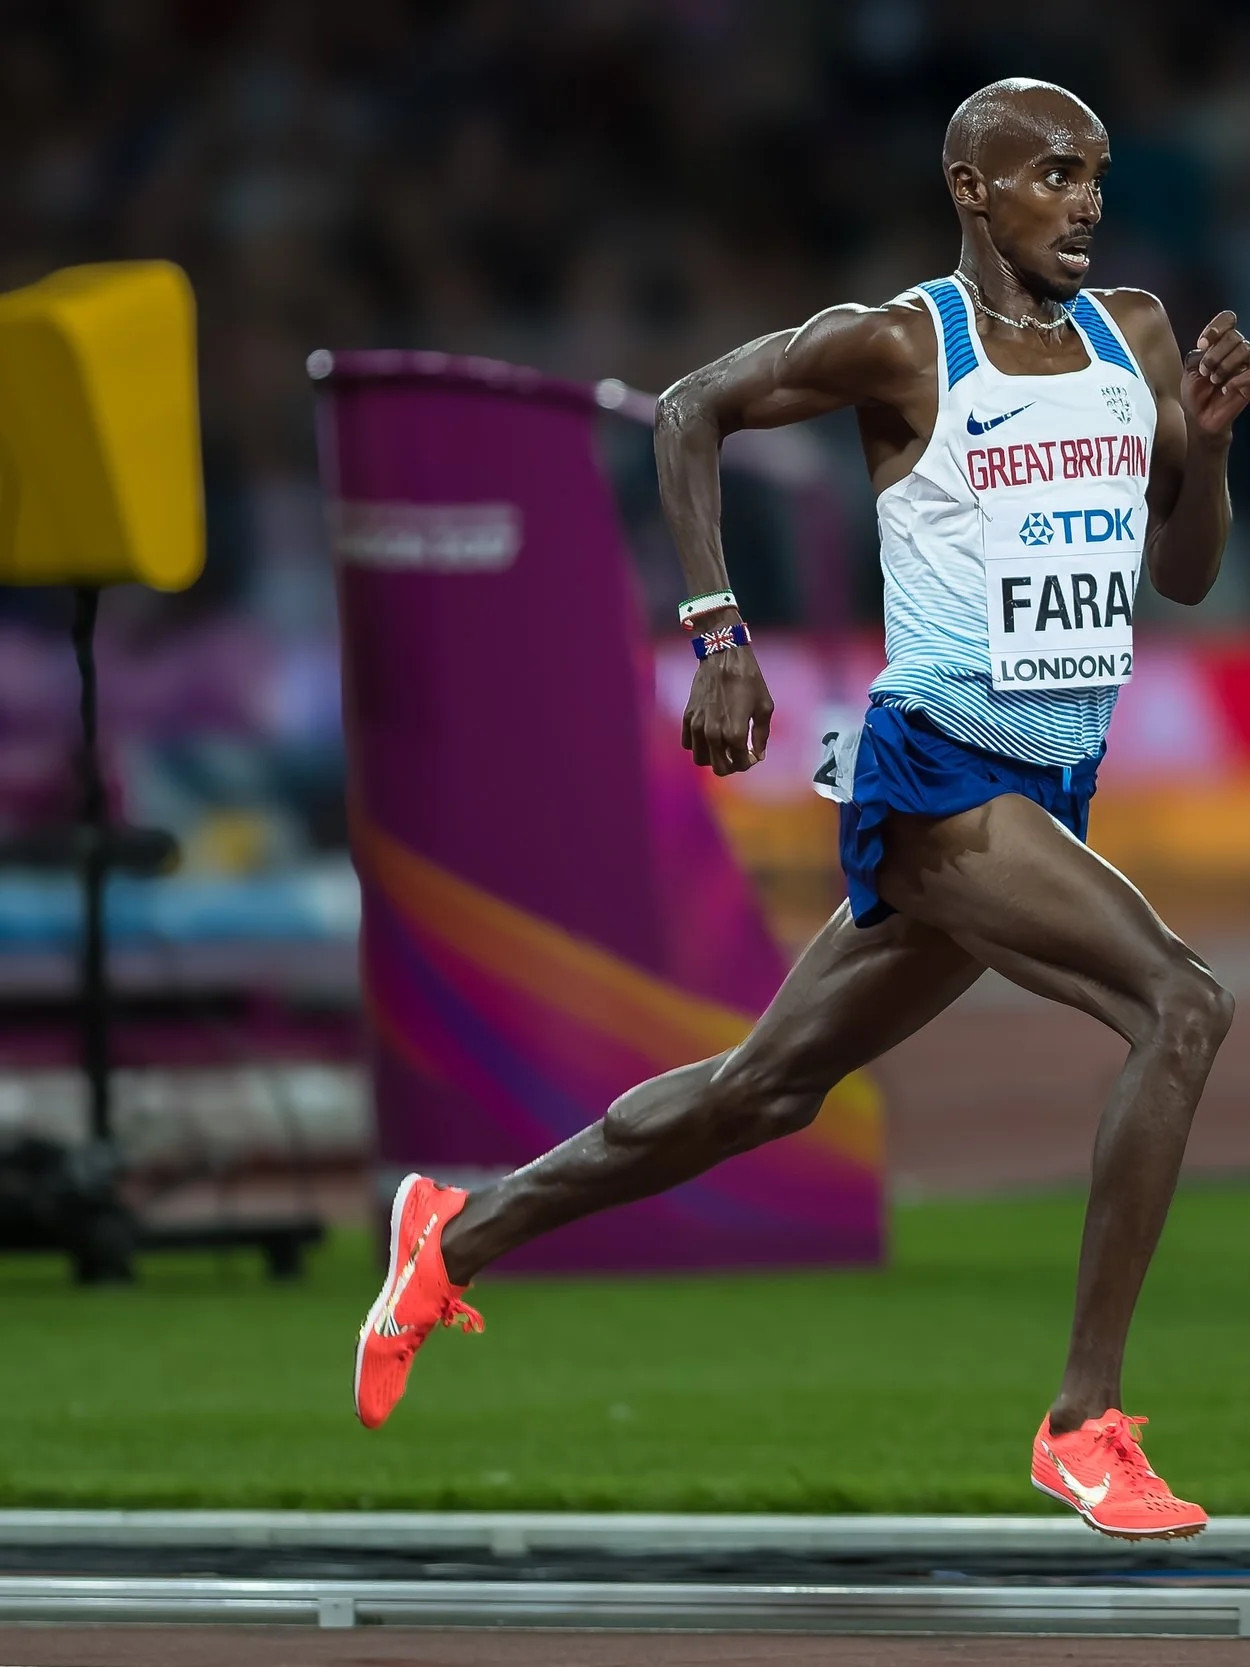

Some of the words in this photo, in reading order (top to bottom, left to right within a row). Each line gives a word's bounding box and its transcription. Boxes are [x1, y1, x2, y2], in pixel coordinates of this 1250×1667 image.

[967, 441, 1056, 490] GREAT
[1061, 434, 1147, 479] BRITAIN
[1053, 507, 1135, 544] TDK
[1001, 570, 1136, 633] FARA
[1000, 654, 1116, 681] LONDON
